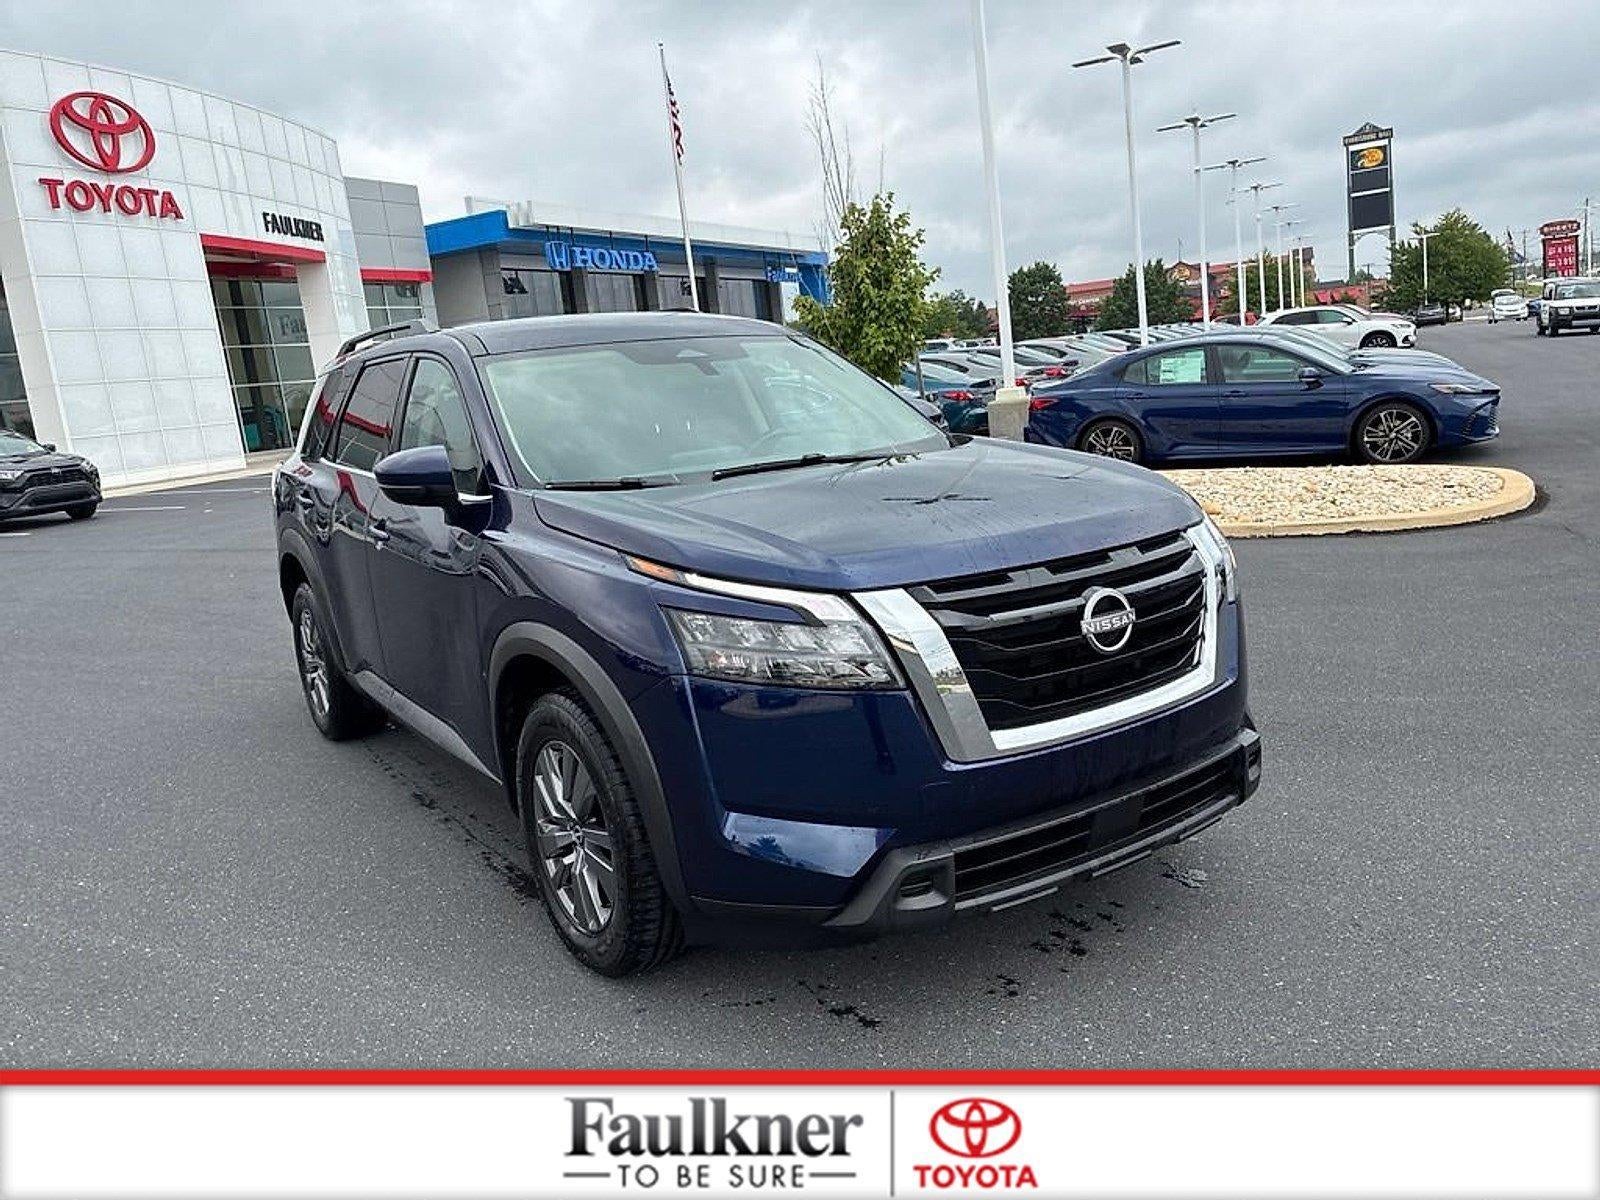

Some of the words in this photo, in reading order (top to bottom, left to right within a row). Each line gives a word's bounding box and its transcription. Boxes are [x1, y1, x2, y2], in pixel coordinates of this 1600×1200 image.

[38, 178, 184, 220] TOYOTA
[262, 211, 325, 242] FAULKNER
[571, 246, 659, 272] HONDA
[1081, 609, 1136, 635] NISSAN
